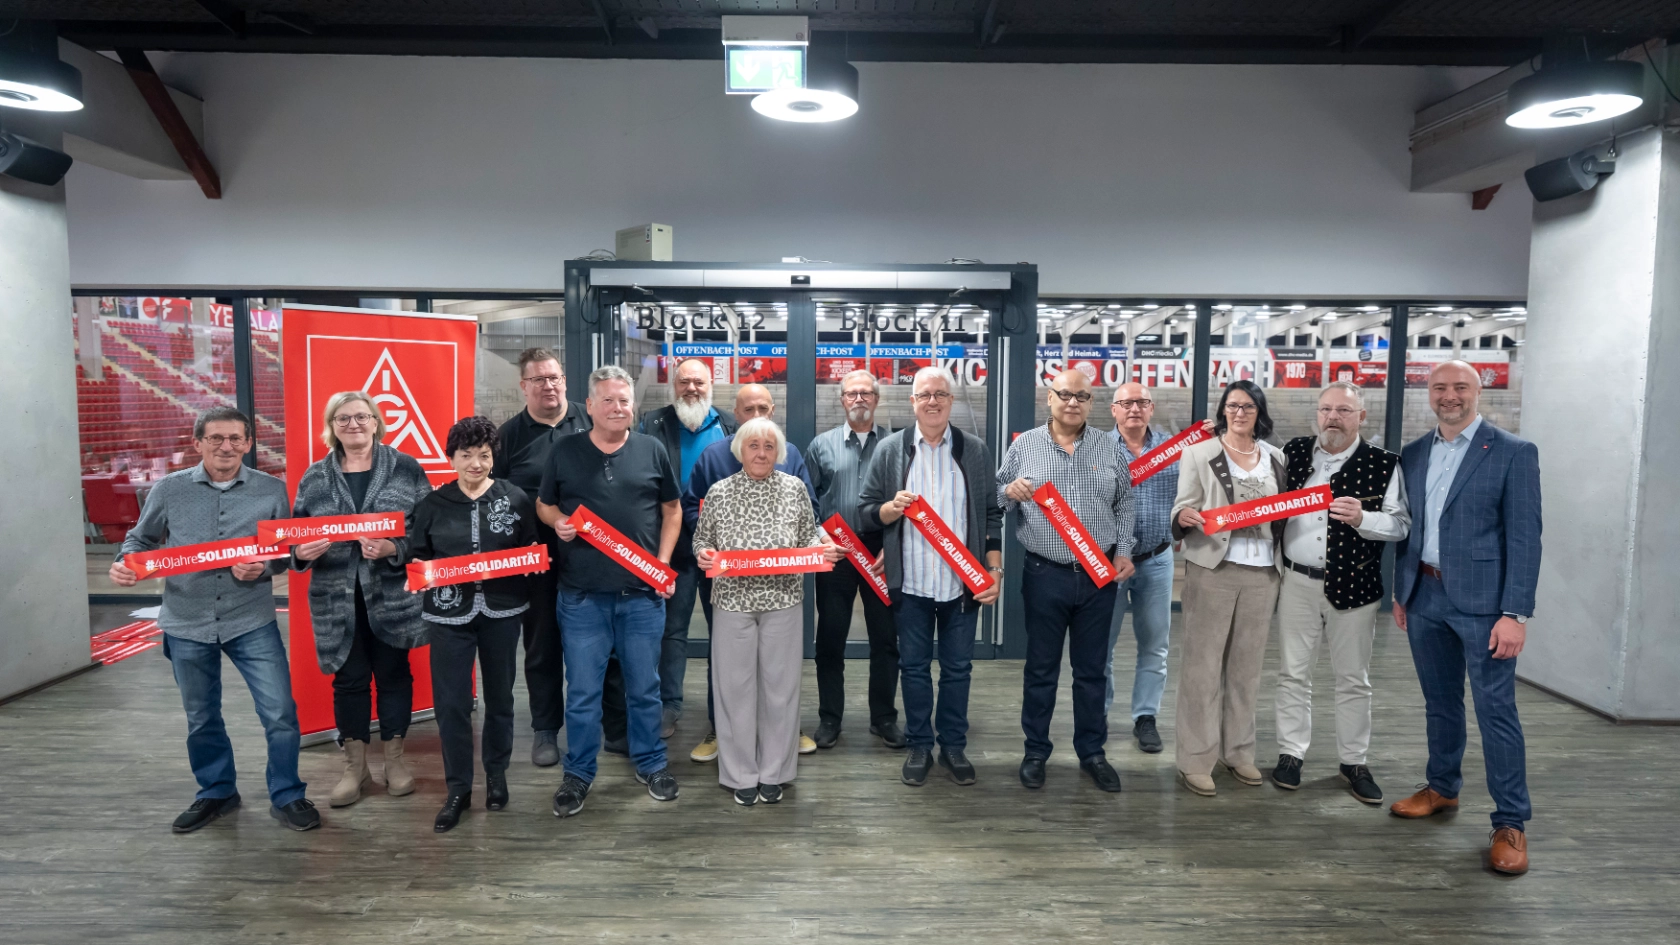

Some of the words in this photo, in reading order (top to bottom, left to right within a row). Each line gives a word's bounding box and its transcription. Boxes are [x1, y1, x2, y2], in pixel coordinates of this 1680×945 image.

[636, 305, 725, 330] Block
[738, 313, 766, 330] 12
[839, 307, 932, 332] Block
[940, 314, 966, 332] 11
[713, 358, 724, 381] 1921
[1216, 493, 1325, 525] #40JahreSOLIDARITÄT
[276, 518, 397, 540] #40JahreSOLIDARITÄT
[1044, 497, 1109, 581] #40JahreSOLIDARITÄT
[582, 520, 669, 584] #40JahreSOLIDARITÄT
[719, 552, 824, 570] #40JahreSOLIDARITÄT
[916, 510, 986, 587] #40JahreSOLIDARITÄT
[424, 552, 541, 582] #40JahreSOLIDARITÄT
